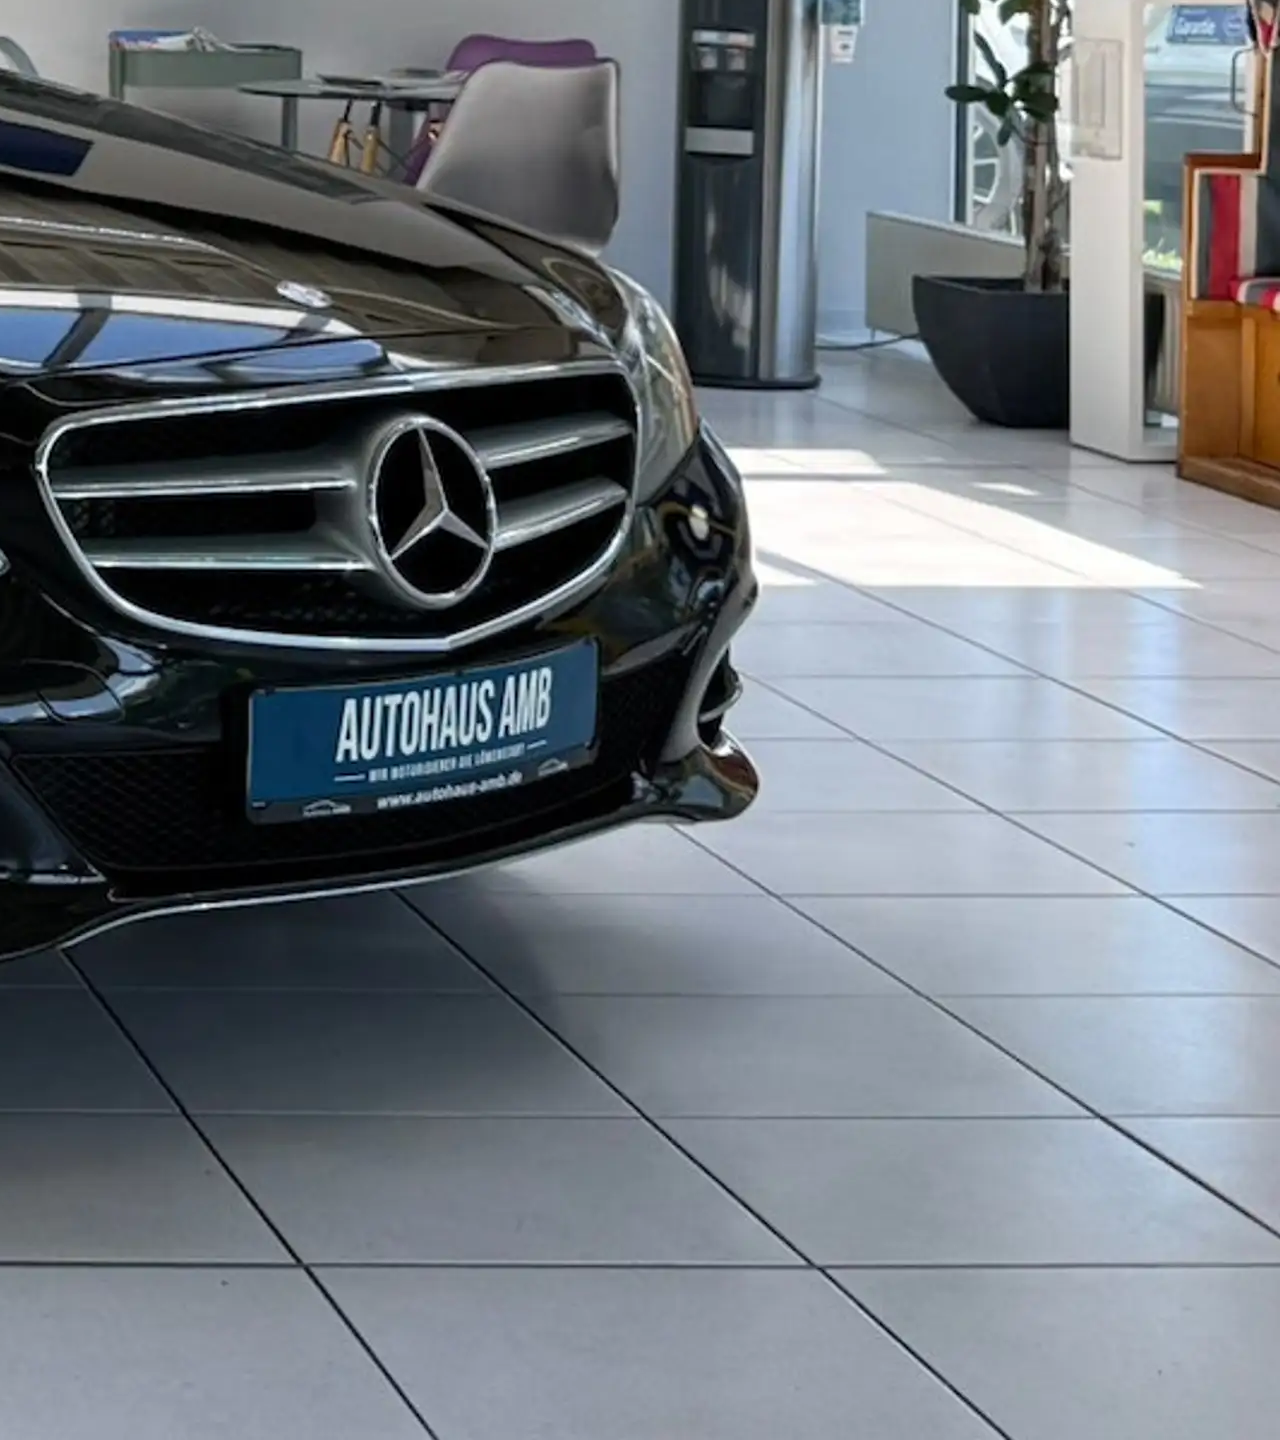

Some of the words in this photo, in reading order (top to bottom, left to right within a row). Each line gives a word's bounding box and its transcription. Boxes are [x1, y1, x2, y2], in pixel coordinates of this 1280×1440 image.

[335, 680, 495, 764] AUTOHAUS
[498, 666, 553, 740] AMB
[377, 770, 523, 810] www.autohaus-amb.de
